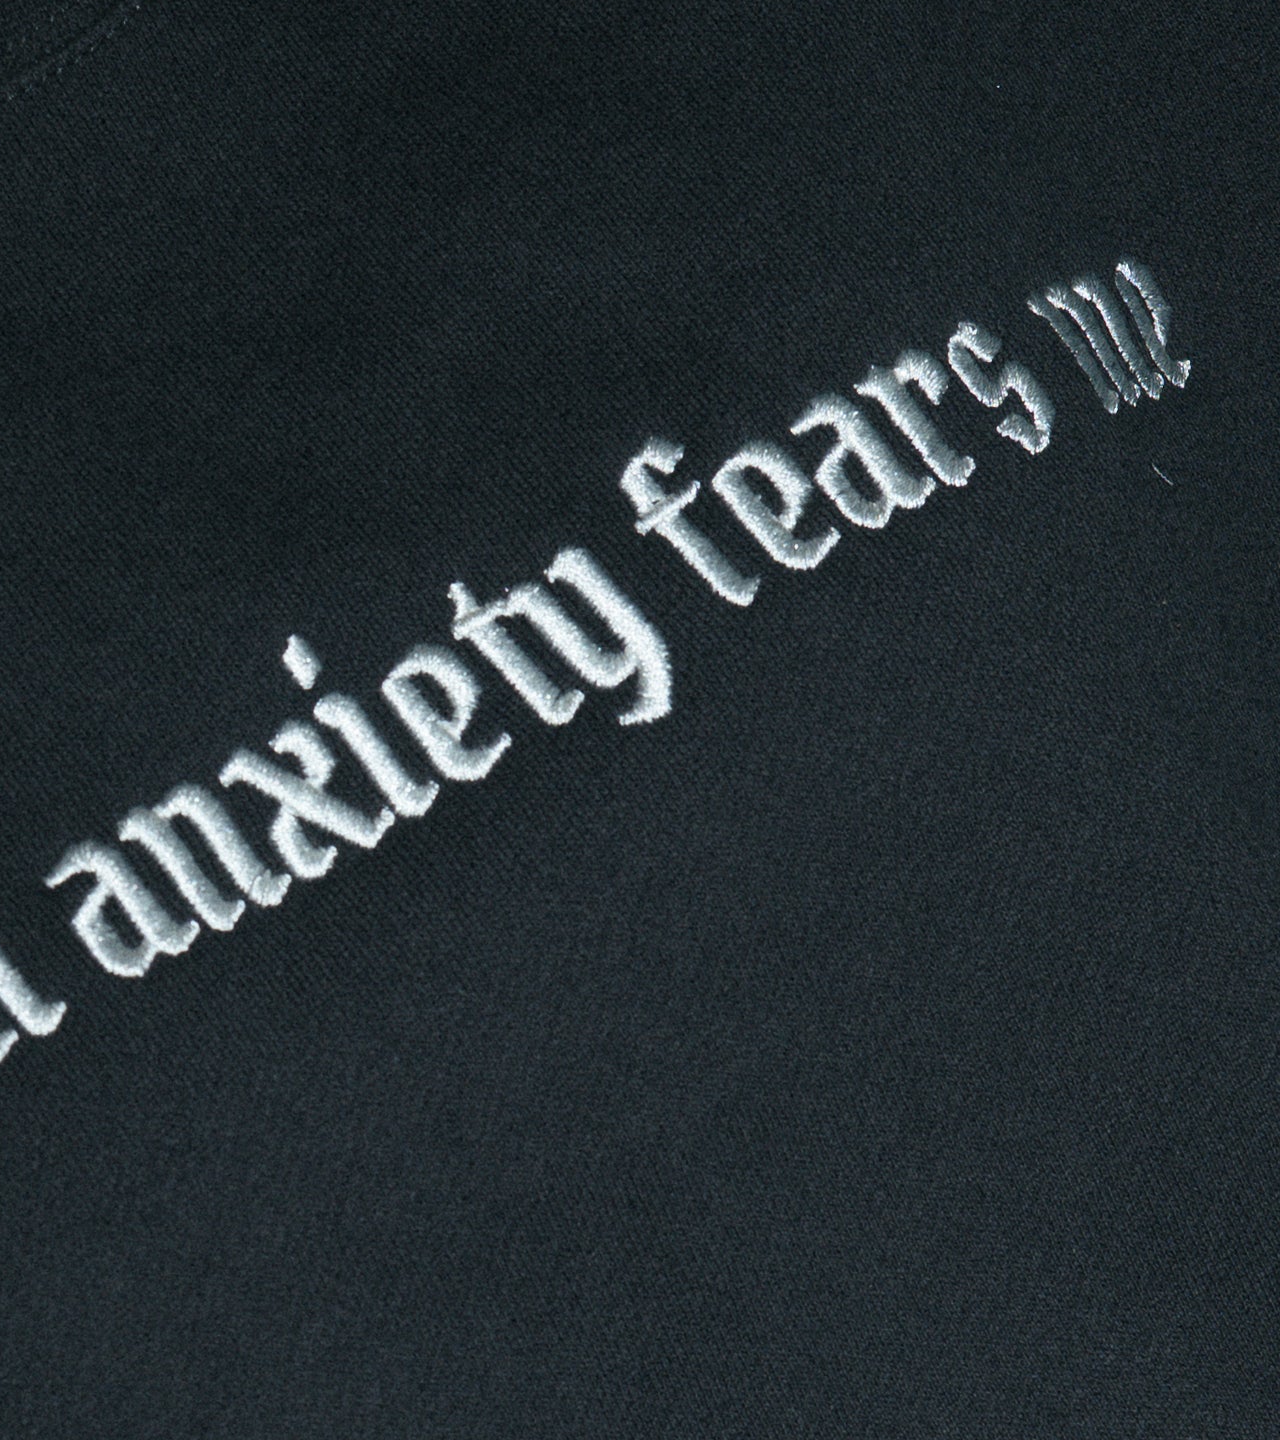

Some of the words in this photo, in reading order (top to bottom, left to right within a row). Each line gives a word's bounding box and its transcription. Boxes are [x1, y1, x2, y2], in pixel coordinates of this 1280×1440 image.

[46, 547, 673, 978] anxiety
[620, 321, 1051, 607] fears
[1026, 257, 1191, 414] me
